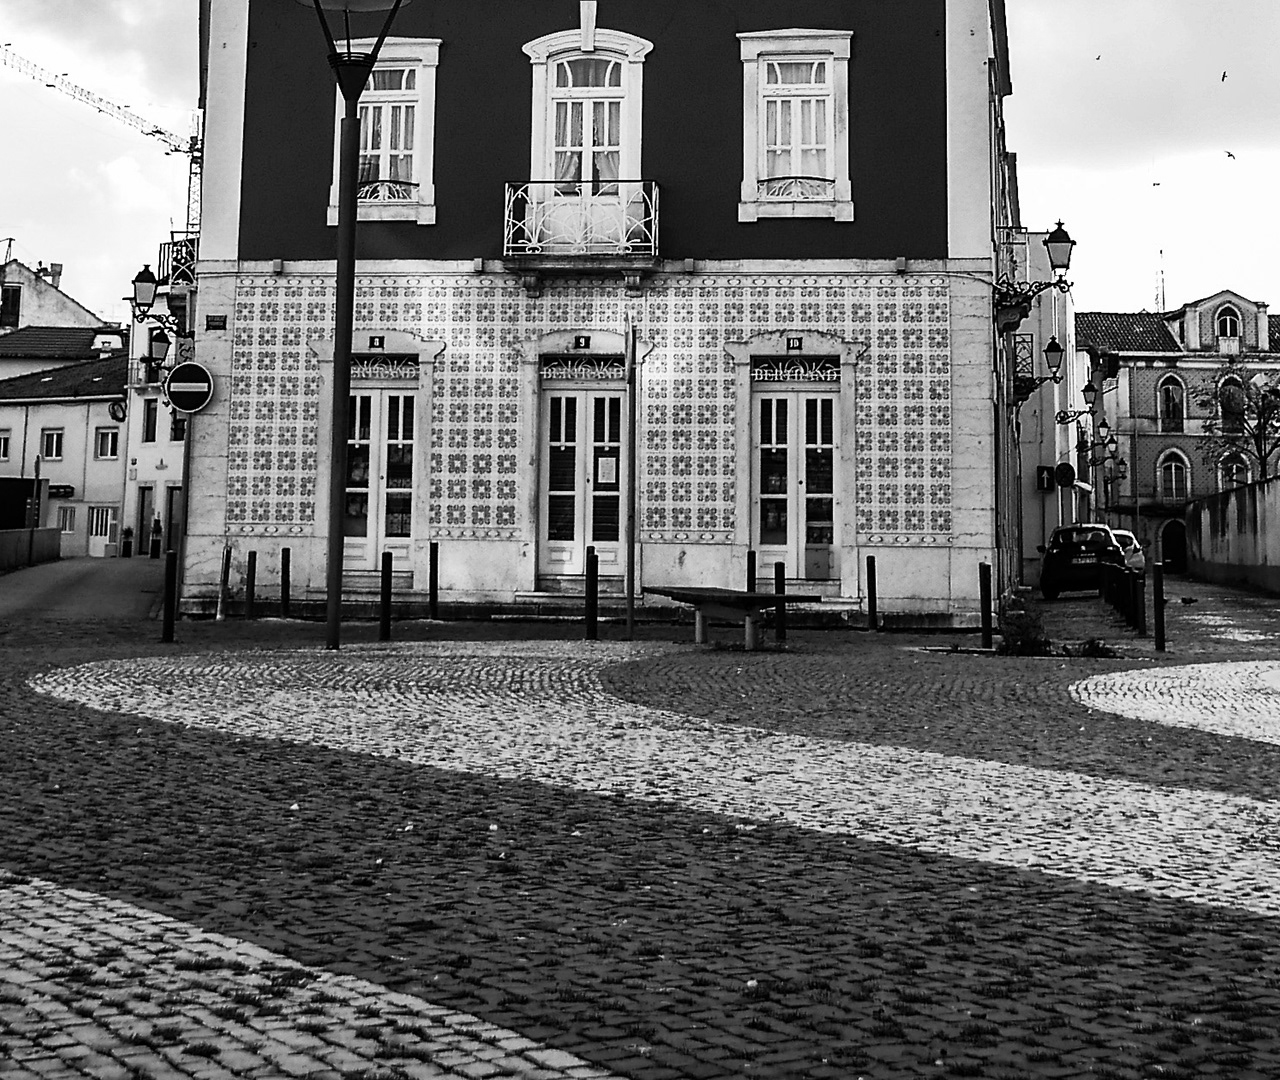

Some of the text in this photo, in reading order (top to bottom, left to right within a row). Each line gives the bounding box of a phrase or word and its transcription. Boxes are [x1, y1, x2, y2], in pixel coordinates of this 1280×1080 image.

[373, 337, 380, 347] 8
[579, 337, 586, 347] 9
[351, 366, 416, 378] ERTRAND
[542, 367, 625, 379] BERTRAND
[754, 368, 838, 381] BERTRAND
